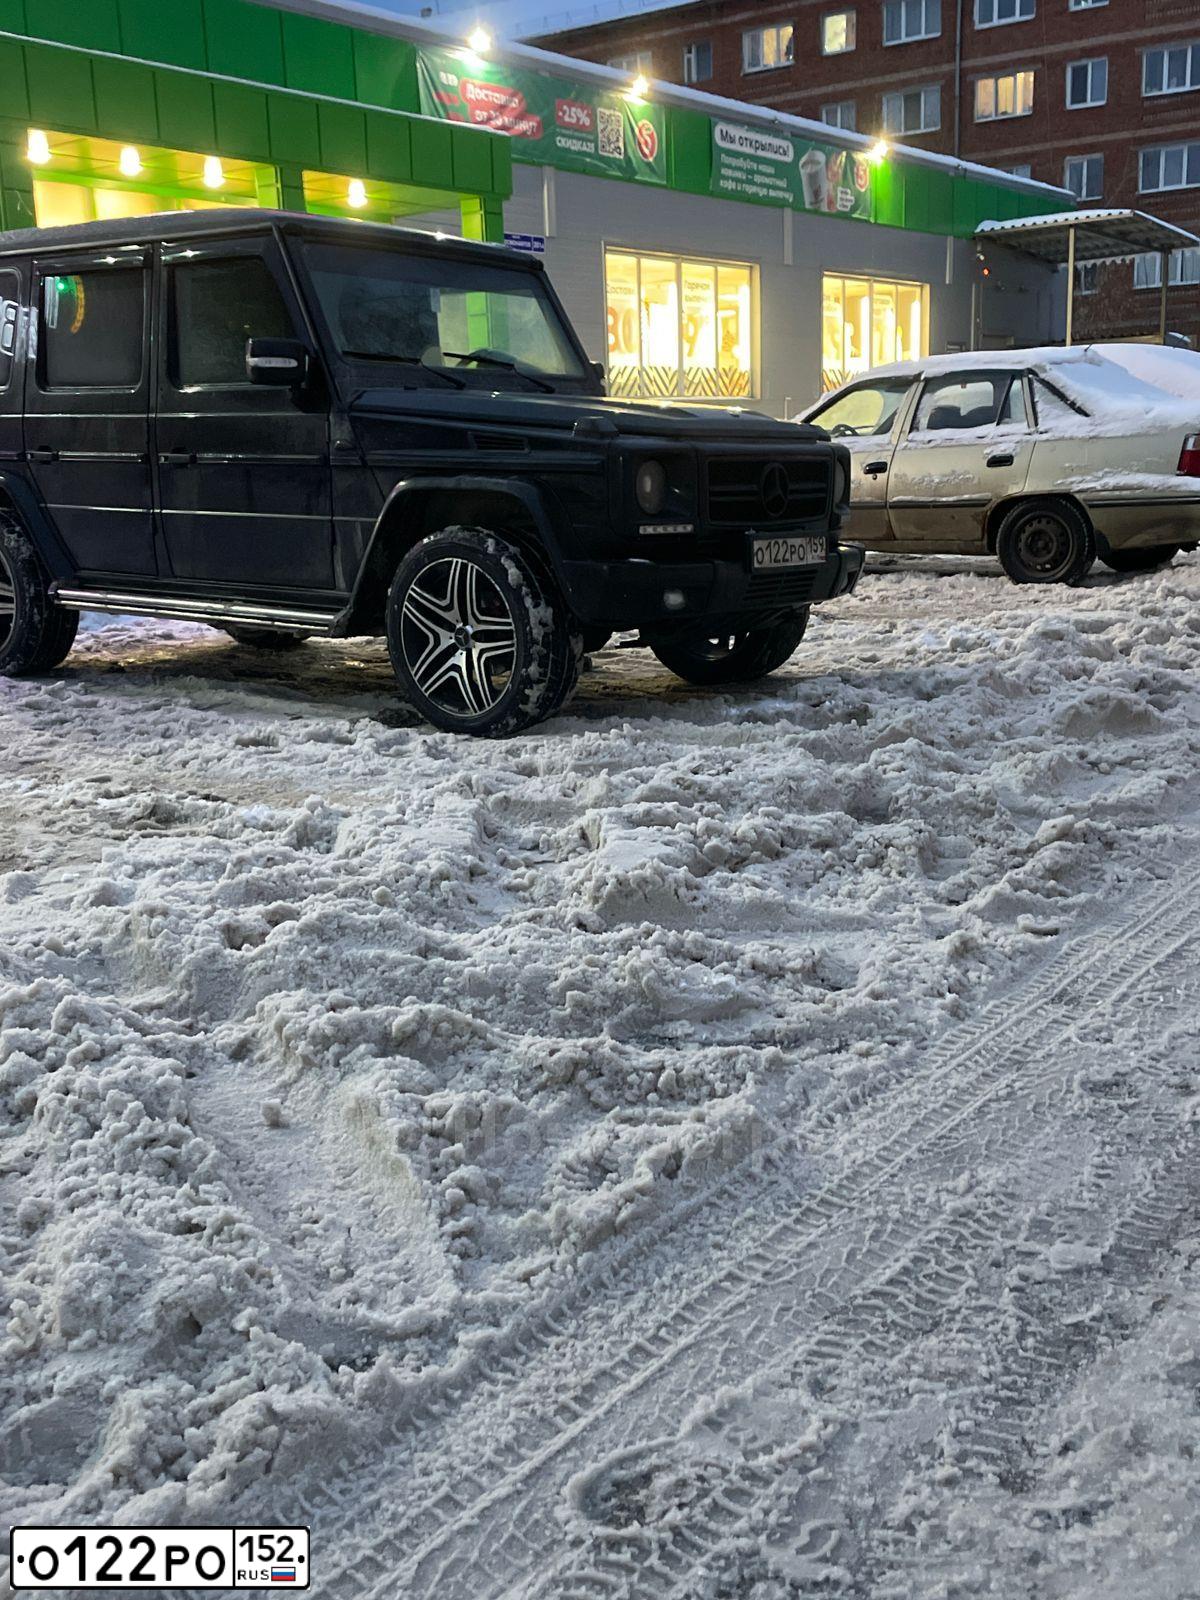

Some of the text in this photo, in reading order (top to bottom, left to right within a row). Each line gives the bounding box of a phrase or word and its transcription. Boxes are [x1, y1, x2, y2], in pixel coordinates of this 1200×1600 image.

[465, 83, 520, 109] Доставка
[559, 104, 591, 127] -25%
[719, 129, 791, 157] Мы открылись!
[755, 540, 806, 565] О122РО
